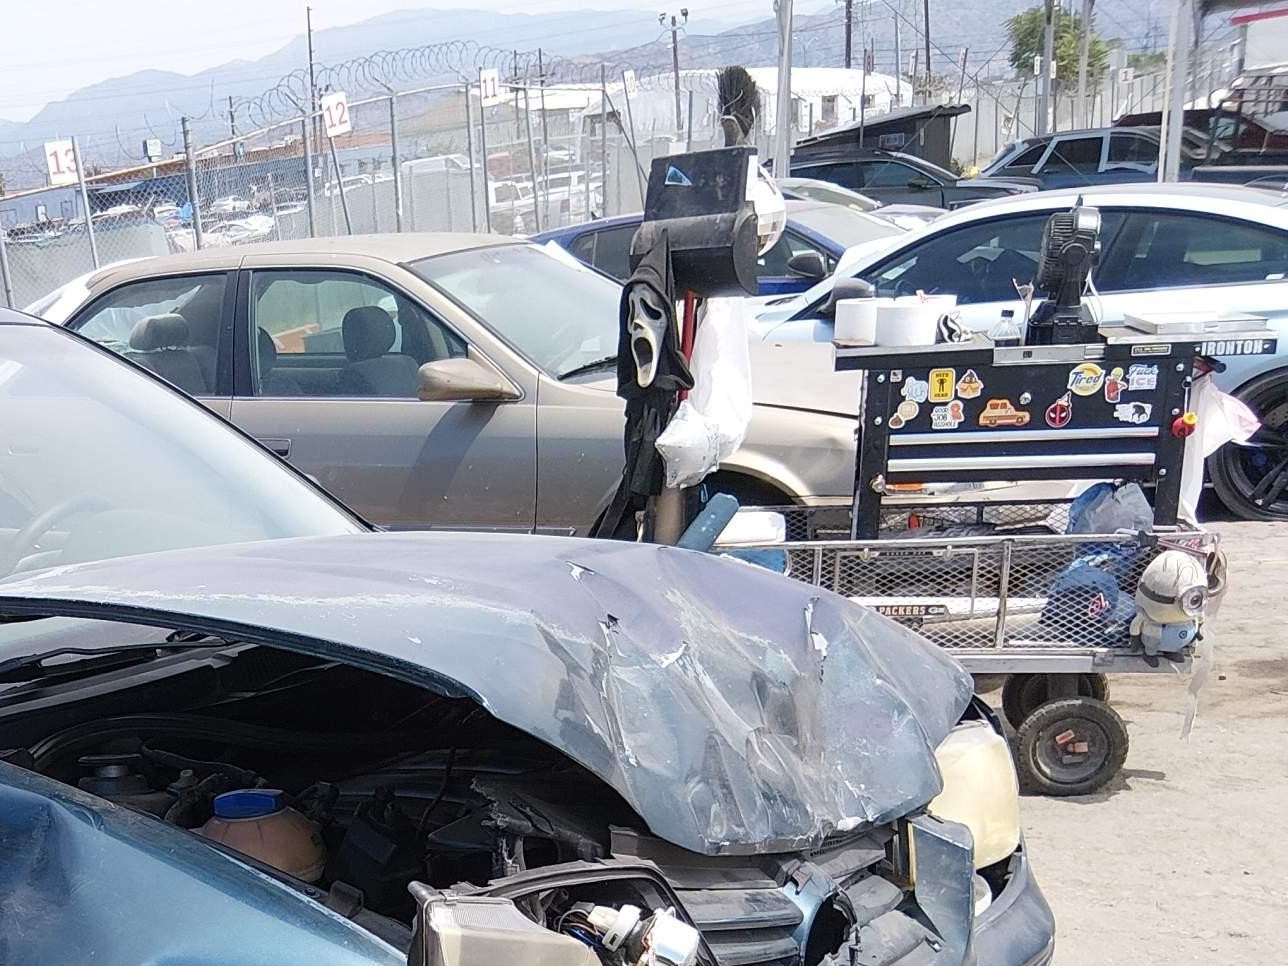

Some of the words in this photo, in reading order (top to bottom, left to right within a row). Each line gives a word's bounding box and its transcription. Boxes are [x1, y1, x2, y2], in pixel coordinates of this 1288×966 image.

[482, 77, 498, 99] 11
[325, 101, 348, 129] 12
[49, 148, 77, 175] 13
[1201, 340, 1263, 356] IRONTON
[1069, 371, 1104, 387] Tired
[879, 606, 926, 616] PACKERS
